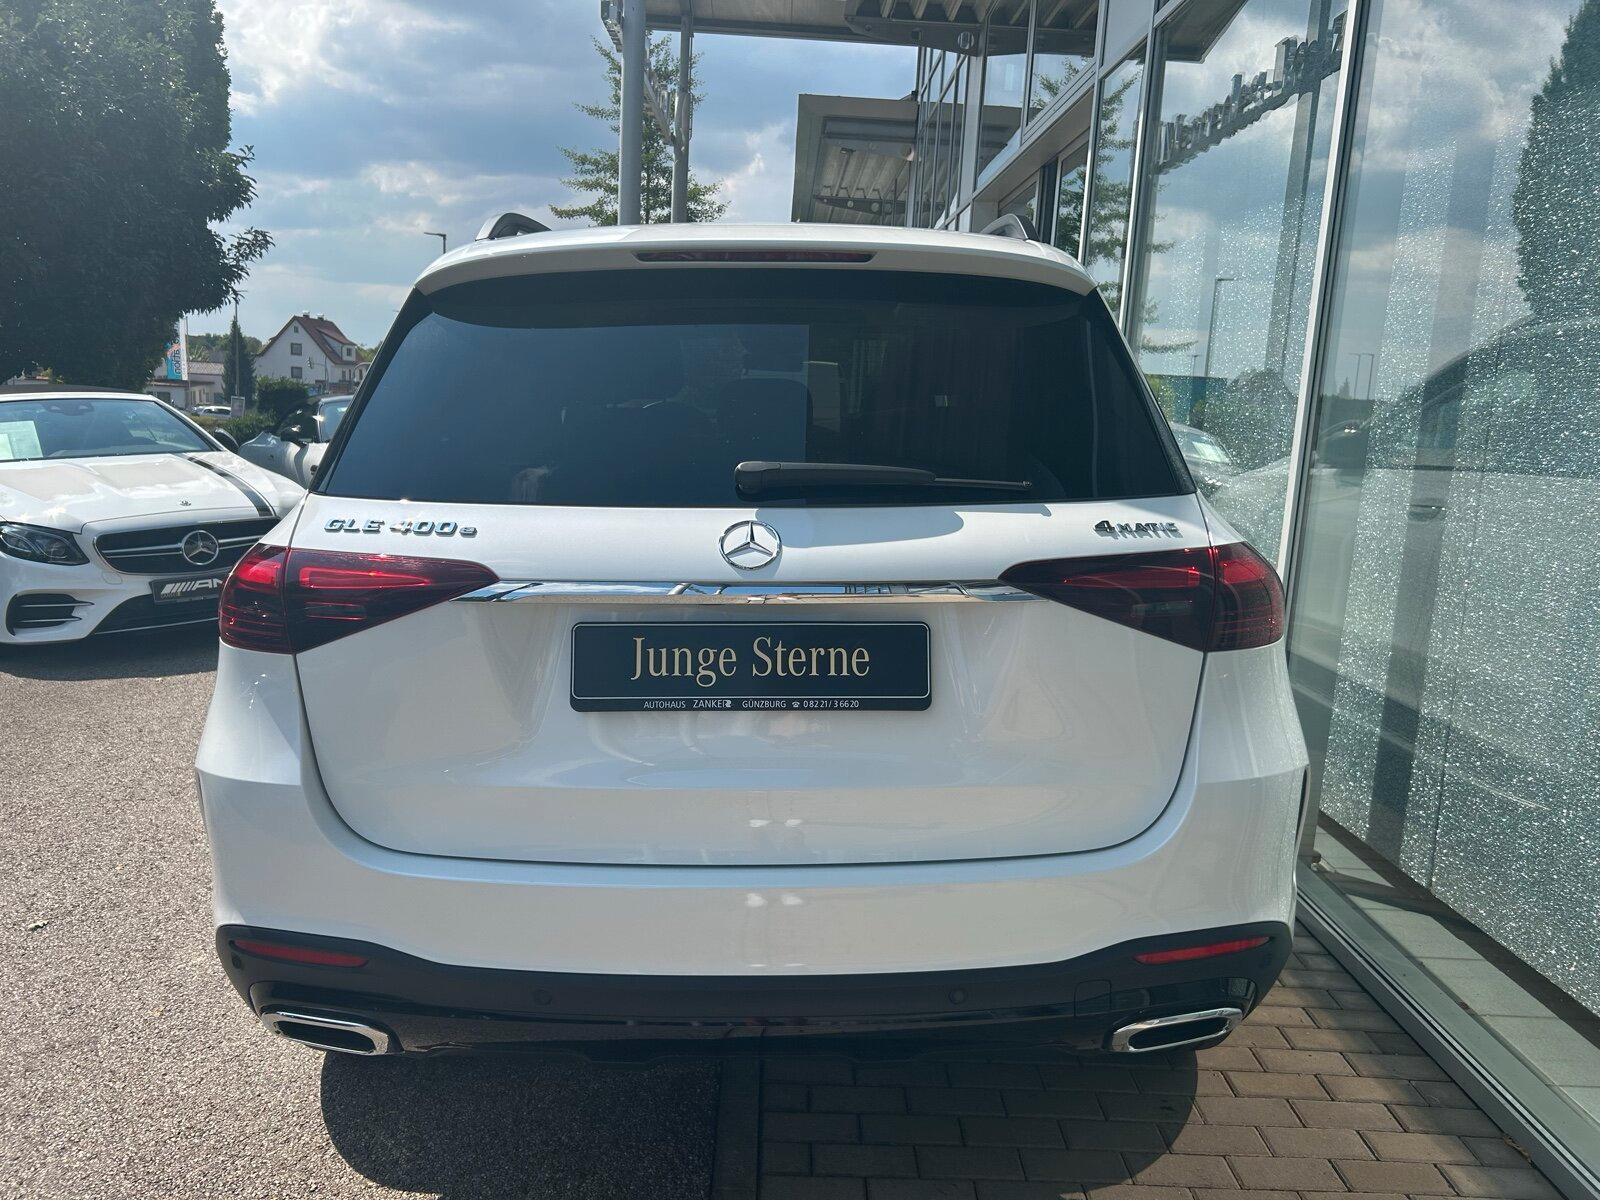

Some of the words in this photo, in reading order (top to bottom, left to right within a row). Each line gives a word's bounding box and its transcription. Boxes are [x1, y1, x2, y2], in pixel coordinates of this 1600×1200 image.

[324, 518, 386, 533] GLE
[389, 519, 478, 538] 400e
[630, 637, 737, 688] Junge
[752, 636, 870, 678] Sterne
[643, 700, 686, 709] AUTOHAUS
[692, 699, 732, 708] ZANKER
[741, 698, 787, 708] GÜNZBURG
